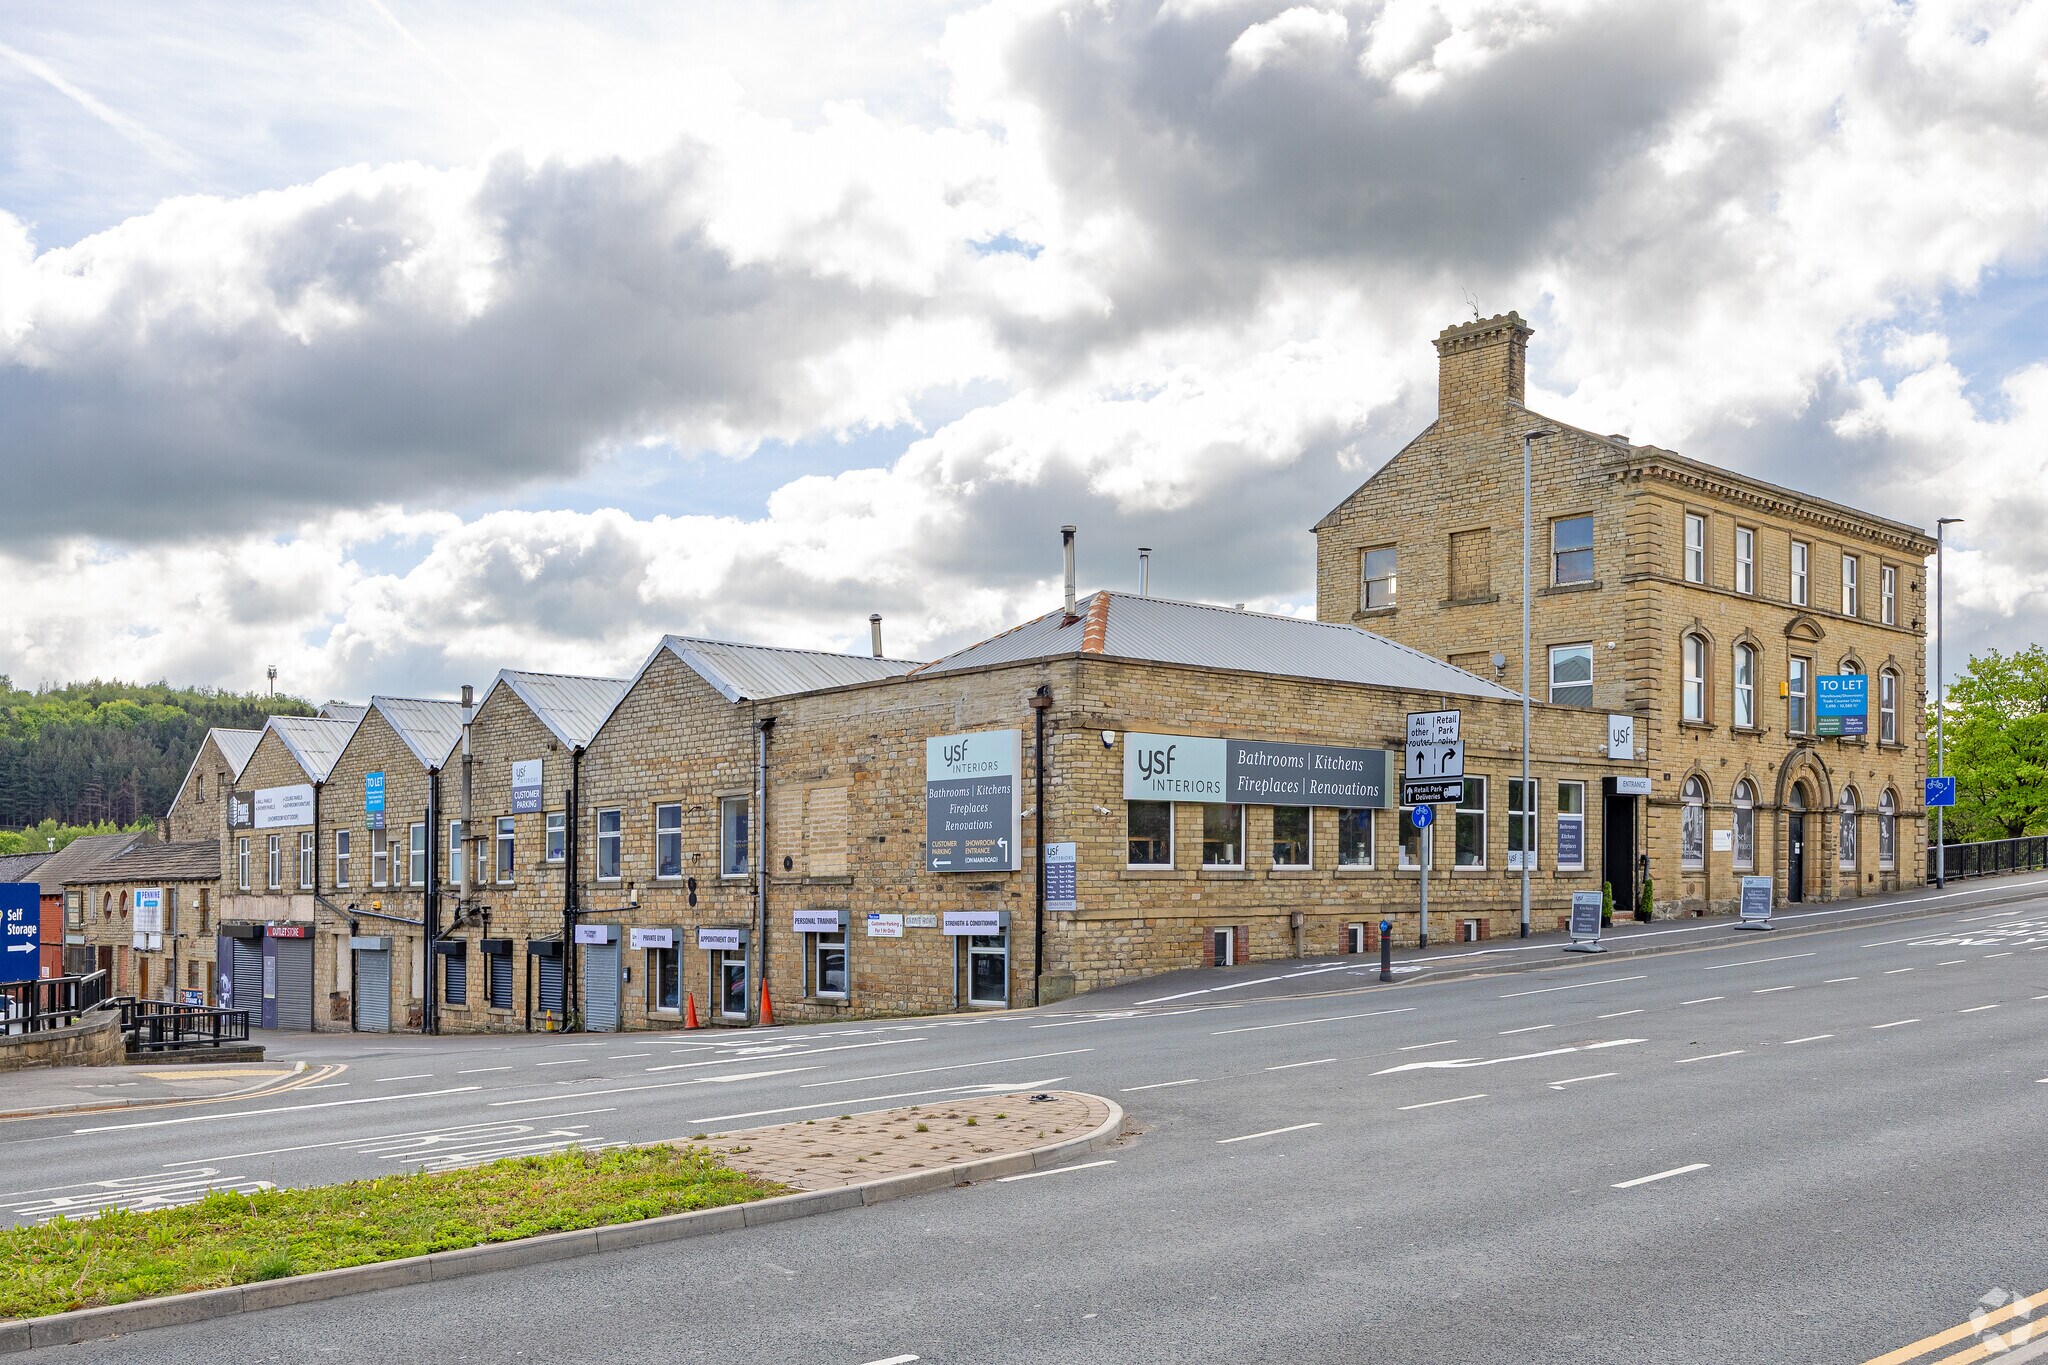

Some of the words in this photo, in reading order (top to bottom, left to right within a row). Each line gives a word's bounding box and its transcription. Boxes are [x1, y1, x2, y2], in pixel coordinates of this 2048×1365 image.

[1820, 681, 1838, 690] TO
[1842, 680, 1864, 690] LET
[1416, 718, 1425, 726] All
[1436, 715, 1456, 724] Retail
[1411, 728, 1429, 736] other
[1438, 726, 1454, 734] Park
[1613, 726, 1630, 747] ysf
[944, 739, 968, 767] ysf
[952, 760, 998, 774] INTERIORS
[1138, 744, 1176, 781] ysf
[1238, 750, 1304, 768] Bathrooms
[1314, 754, 1364, 772] Kitchens
[516, 765, 527, 780] ysf
[929, 786, 970, 798] Bathrooms
[976, 785, 1011, 796] Kitchens
[1152, 779, 1221, 794] INTERIORS
[1238, 776, 1299, 796] Fireplaces
[1309, 780, 1379, 797] Renovations
[514, 790, 540, 800] CUSTOMER
[516, 800, 537, 808] PARKING
[950, 804, 988, 816] Fireplaces
[945, 820, 992, 831] Renovations
[1047, 846, 1059, 858] ysf
[7, 908, 22, 921] Self
[7, 923, 37, 937] Storage
[272, 927, 287, 936] OUTLET
[287, 927, 299, 936] STORE
[700, 936, 726, 944] APPOINTMENT
